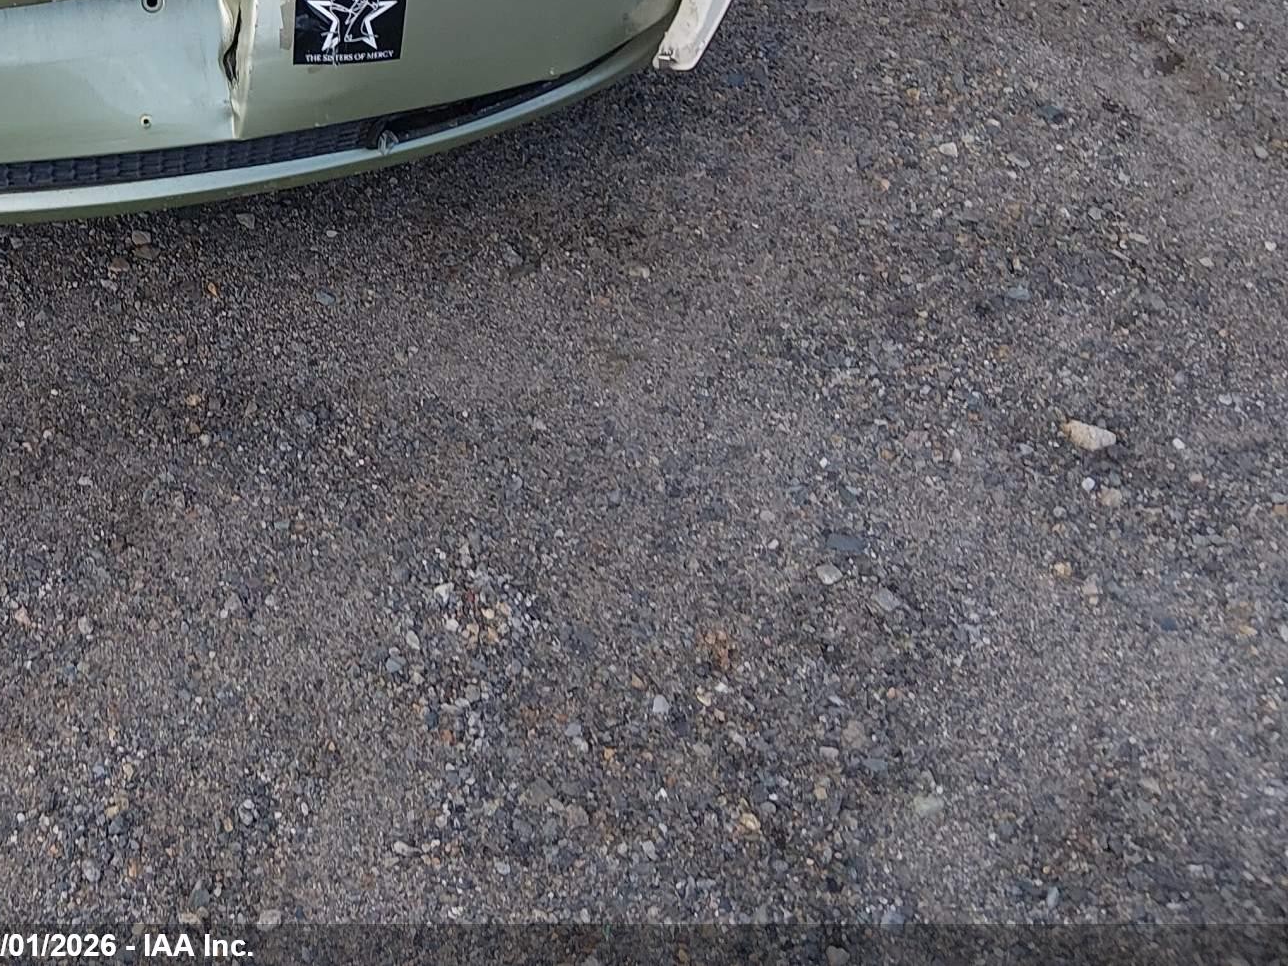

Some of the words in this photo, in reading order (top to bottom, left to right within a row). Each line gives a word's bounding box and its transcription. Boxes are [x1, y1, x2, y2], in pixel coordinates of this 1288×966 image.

[305, 53, 321, 63] THE
[354, 52, 365, 61] OF
[366, 50, 394, 60] MERCY
